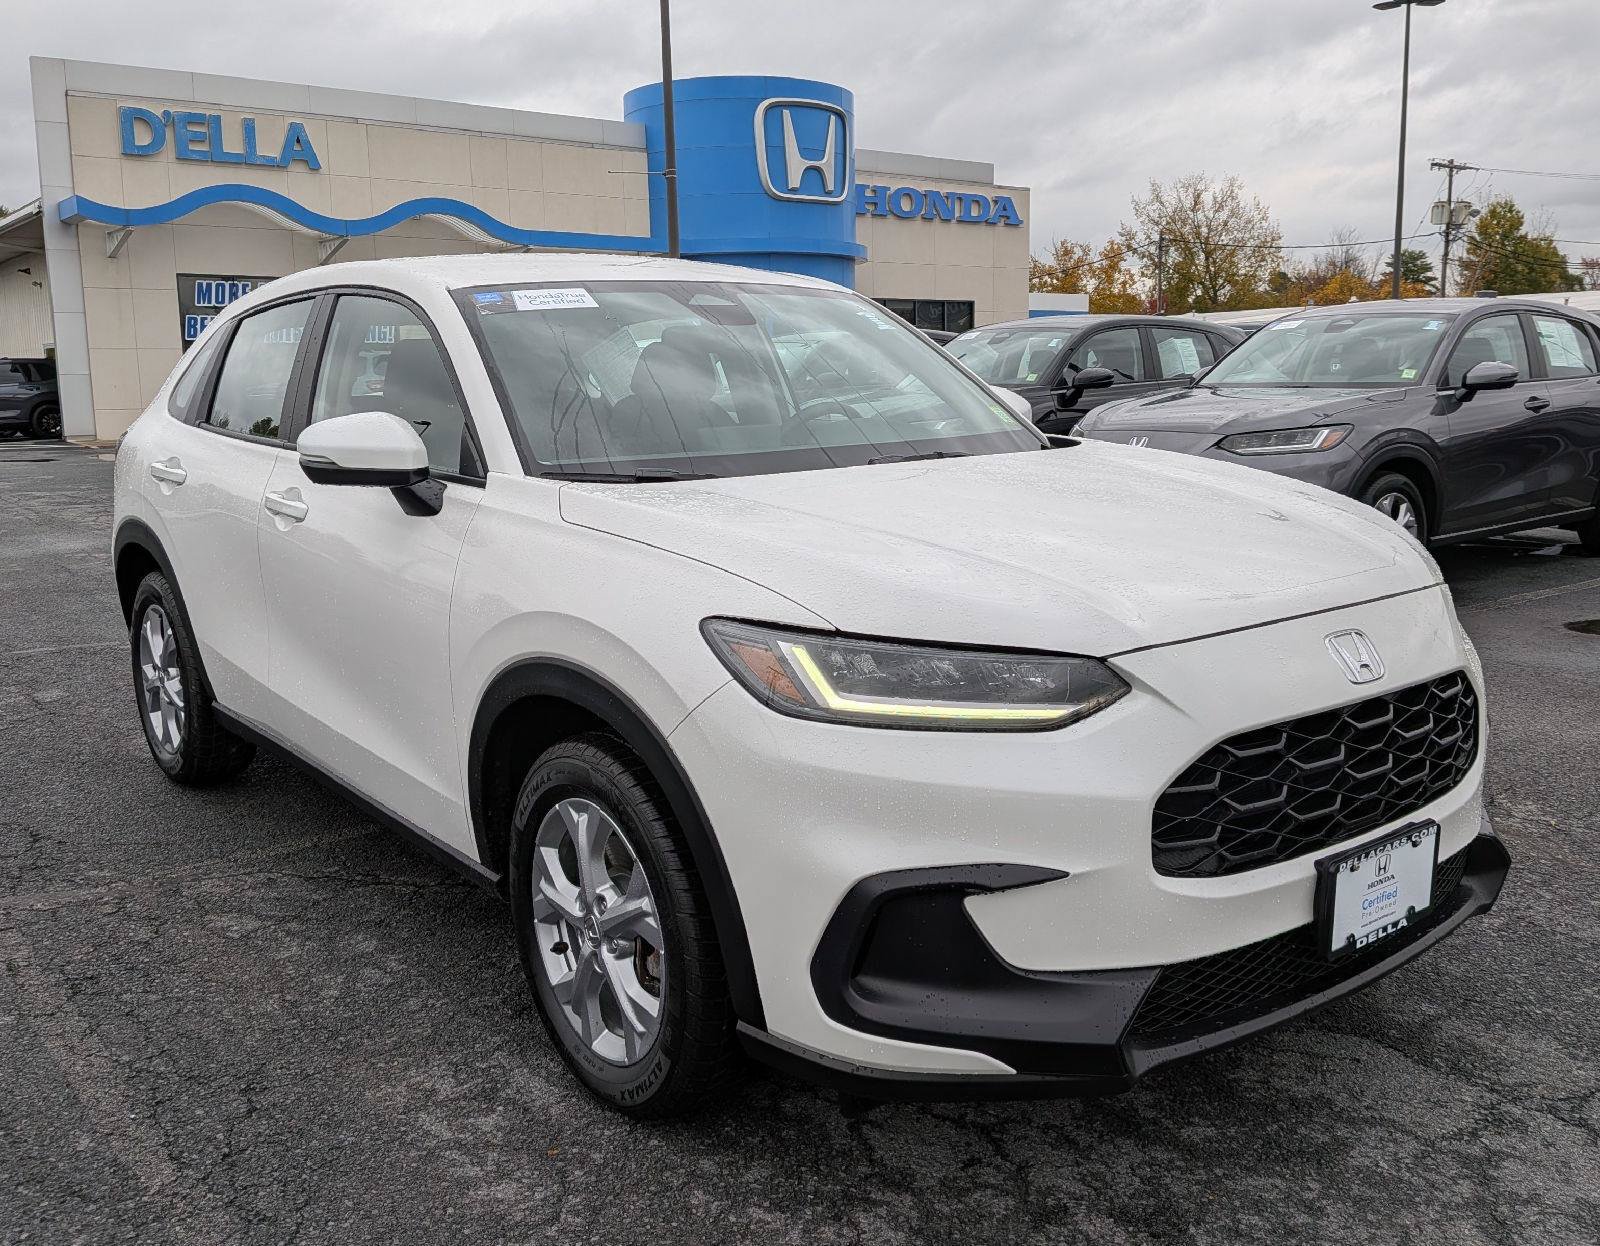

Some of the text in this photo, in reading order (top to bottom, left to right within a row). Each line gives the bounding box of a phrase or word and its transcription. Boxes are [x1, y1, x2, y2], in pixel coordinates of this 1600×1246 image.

[119, 105, 322, 171] D'ELLA
[855, 184, 1023, 225] HONDA
[517, 291, 586, 301] HondaTrue
[528, 297, 586, 306] Certified
[1367, 874, 1396, 890] HONDA
[1362, 886, 1398, 910] Certified
[1356, 918, 1408, 949] DELLA
[620, 1056, 663, 1101] ALTIMAX
